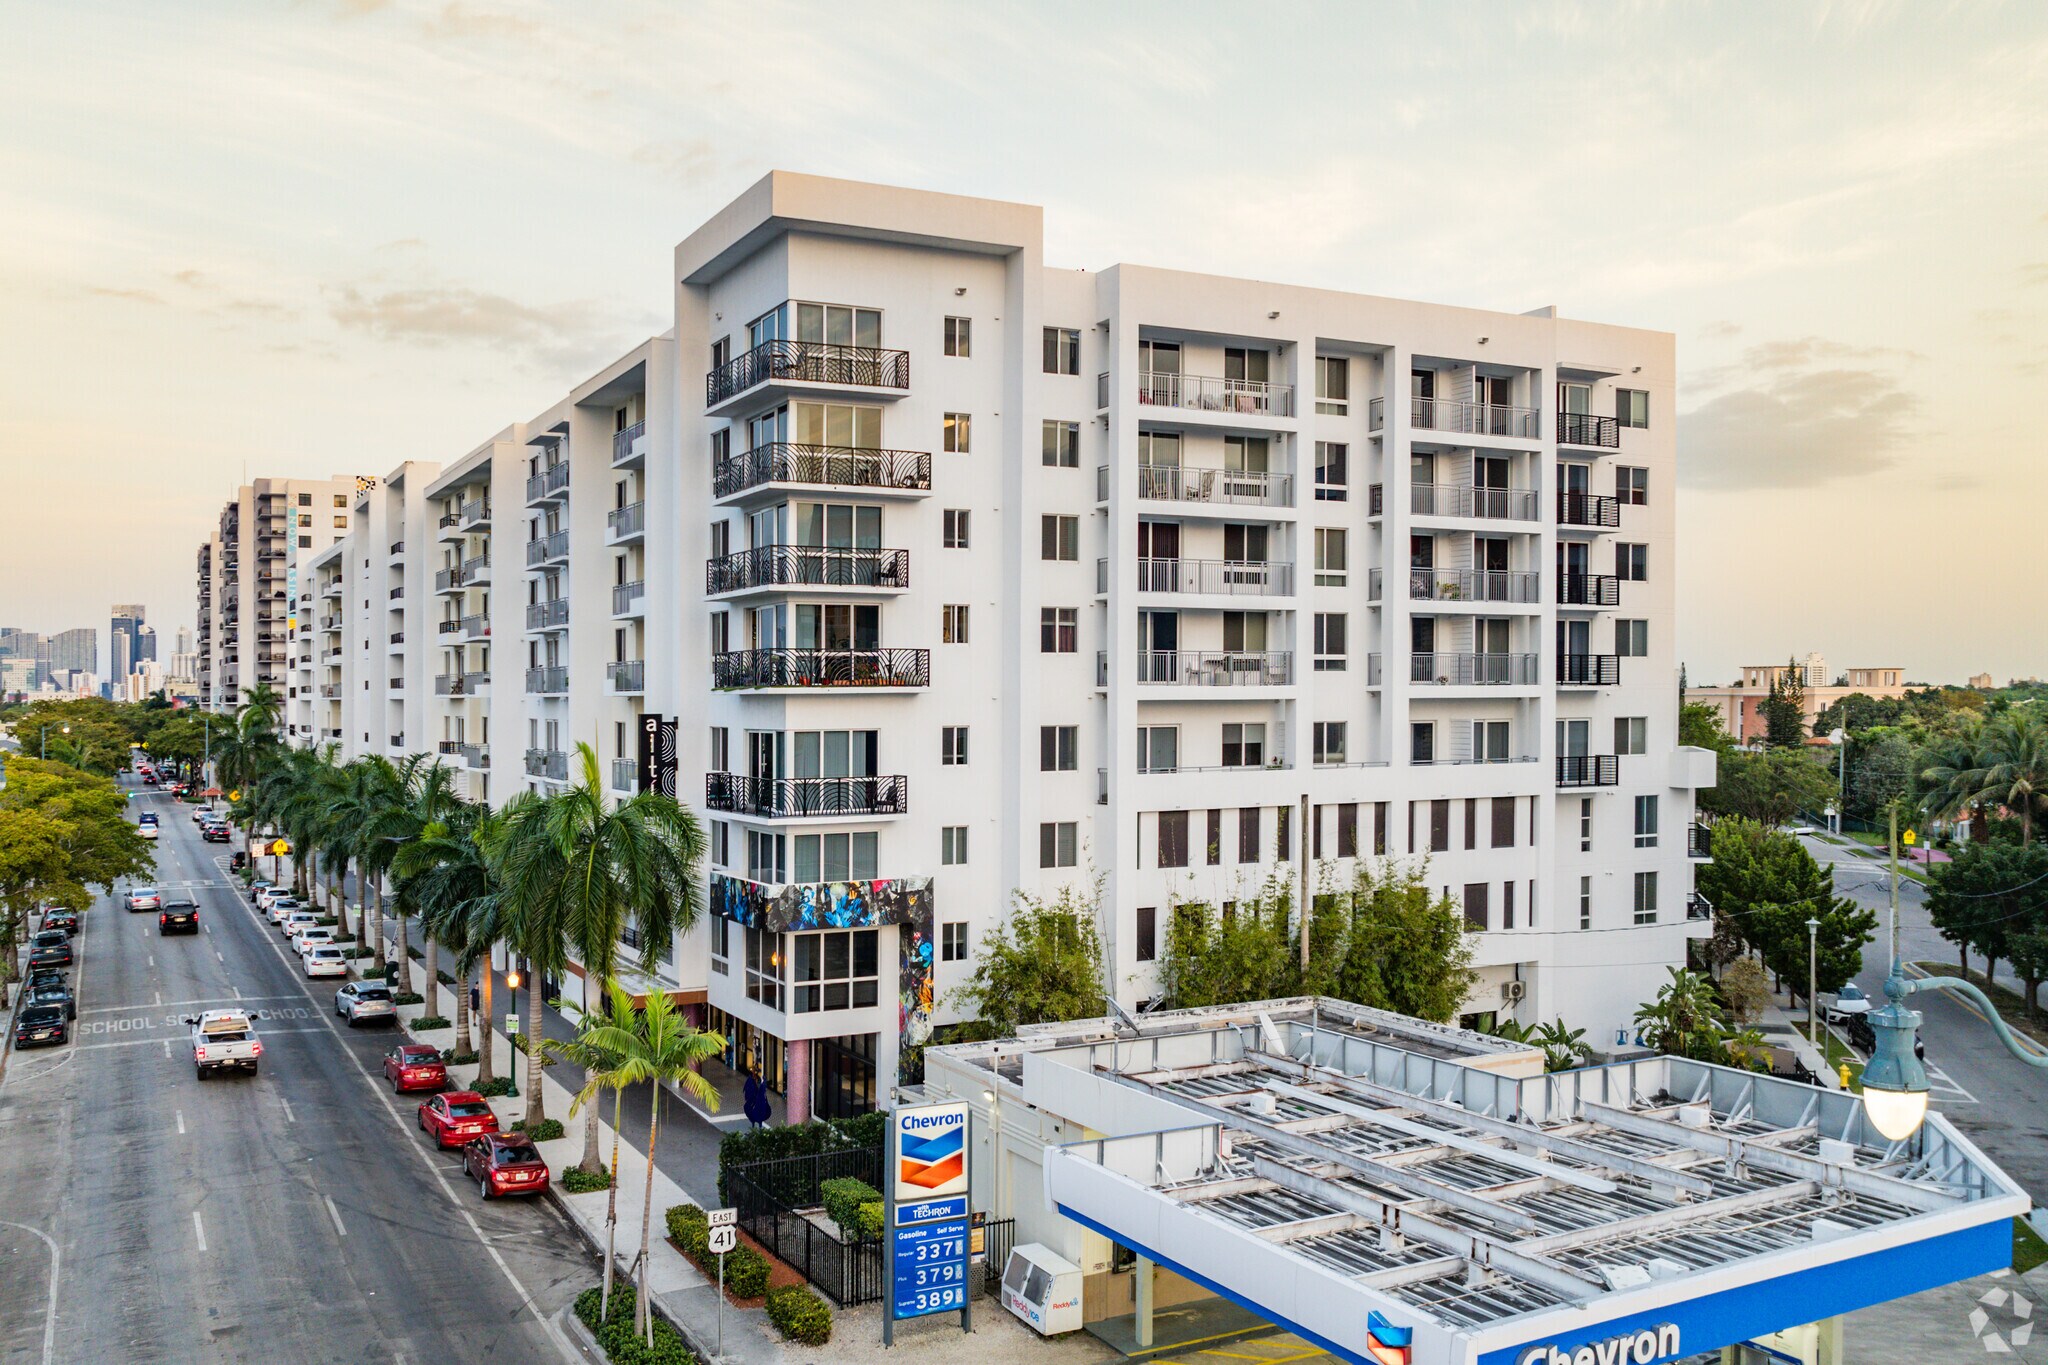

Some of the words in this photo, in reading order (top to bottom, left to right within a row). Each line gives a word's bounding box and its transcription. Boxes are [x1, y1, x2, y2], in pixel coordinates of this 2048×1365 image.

[80, 1017, 157, 1034] SCHOOL
[166, 1012, 202, 1027] SCH
[901, 1113, 964, 1130] Chevron
[712, 1212, 732, 1223] EAST
[913, 1206, 951, 1219] TECHRON
[714, 1230, 731, 1247] 41
[898, 1230, 927, 1240] Gasoline
[936, 1226, 948, 1234] Self
[916, 1241, 954, 1261] 337
[916, 1265, 954, 1285] 379
[916, 1289, 954, 1310] 389
